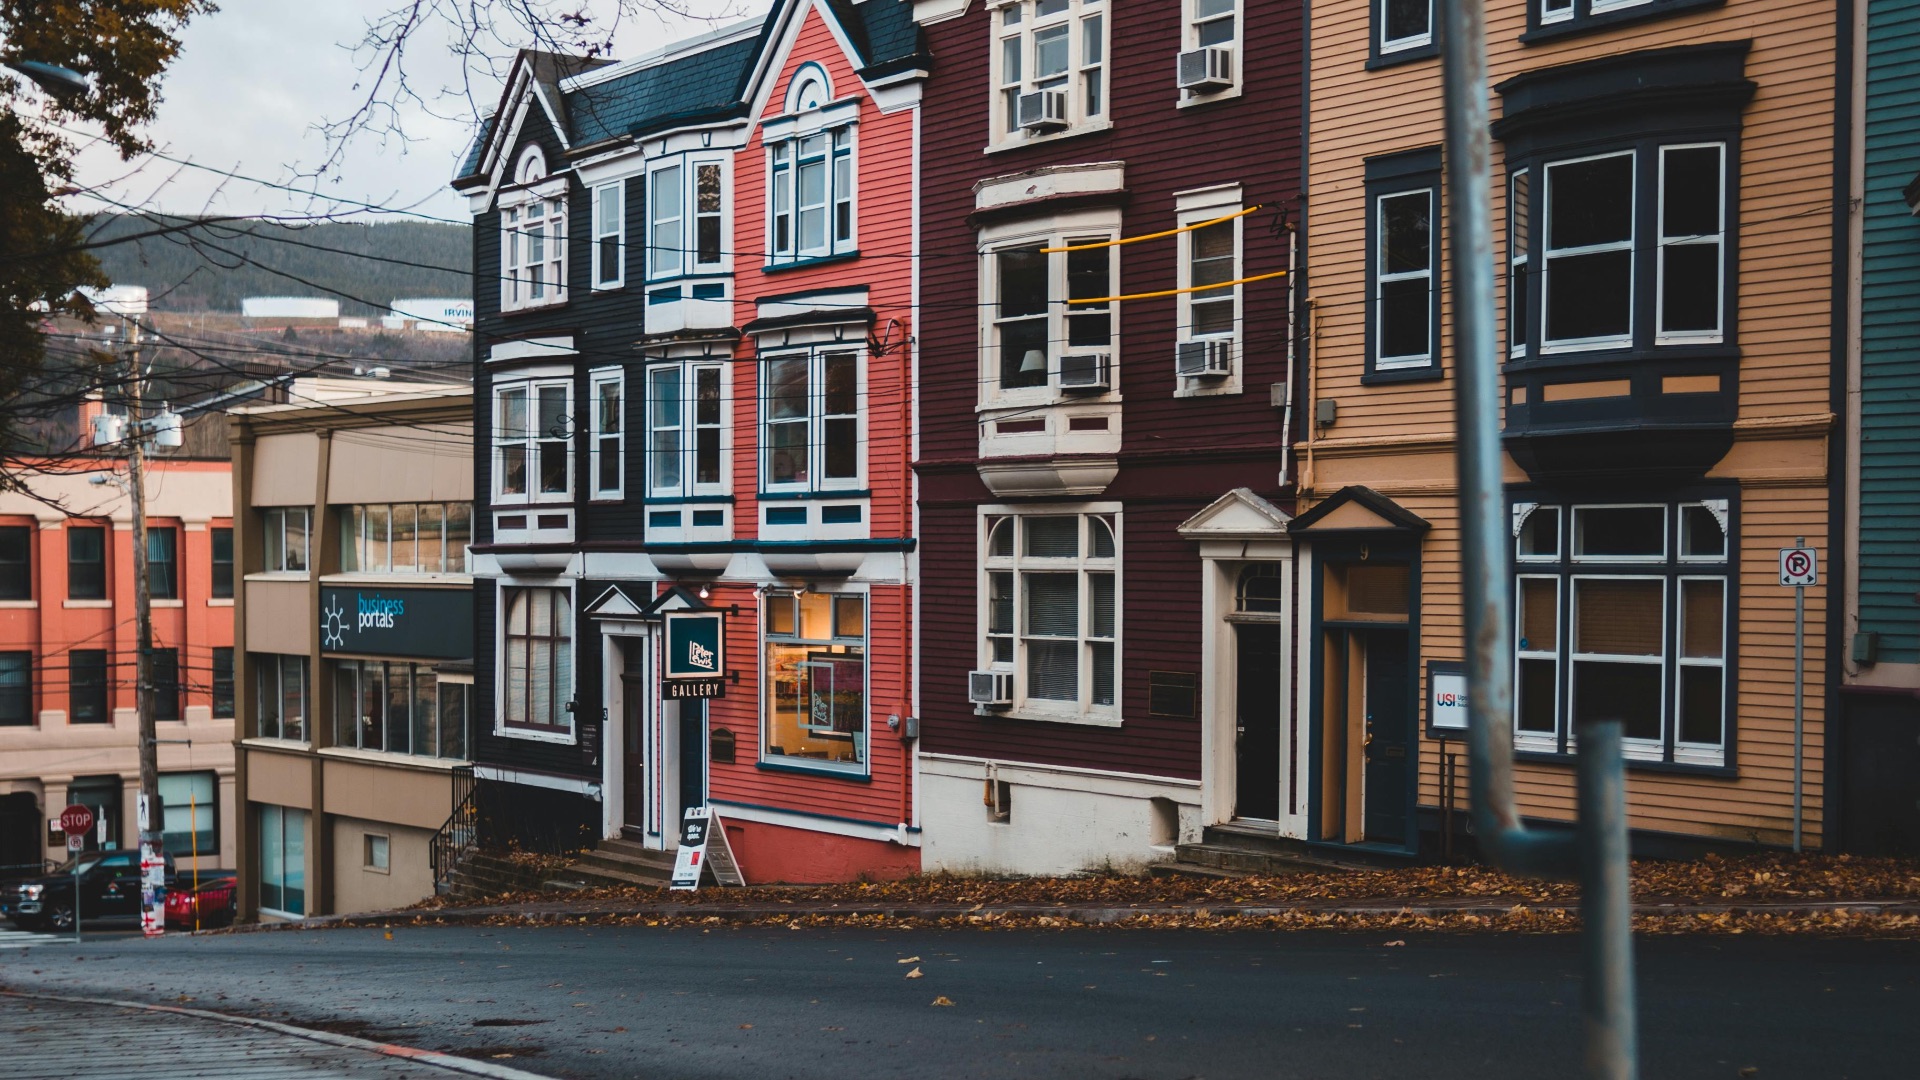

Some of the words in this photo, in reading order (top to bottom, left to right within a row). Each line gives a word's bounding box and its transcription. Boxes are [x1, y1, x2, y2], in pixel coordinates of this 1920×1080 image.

[444, 308, 473, 317] IRVIN
[358, 592, 404, 615] business
[358, 607, 394, 634] portals
[692, 642, 714, 659] Peter
[672, 683, 719, 697] GALLERY
[1437, 693, 1455, 707] USI
[62, 813, 91, 828] STOP
